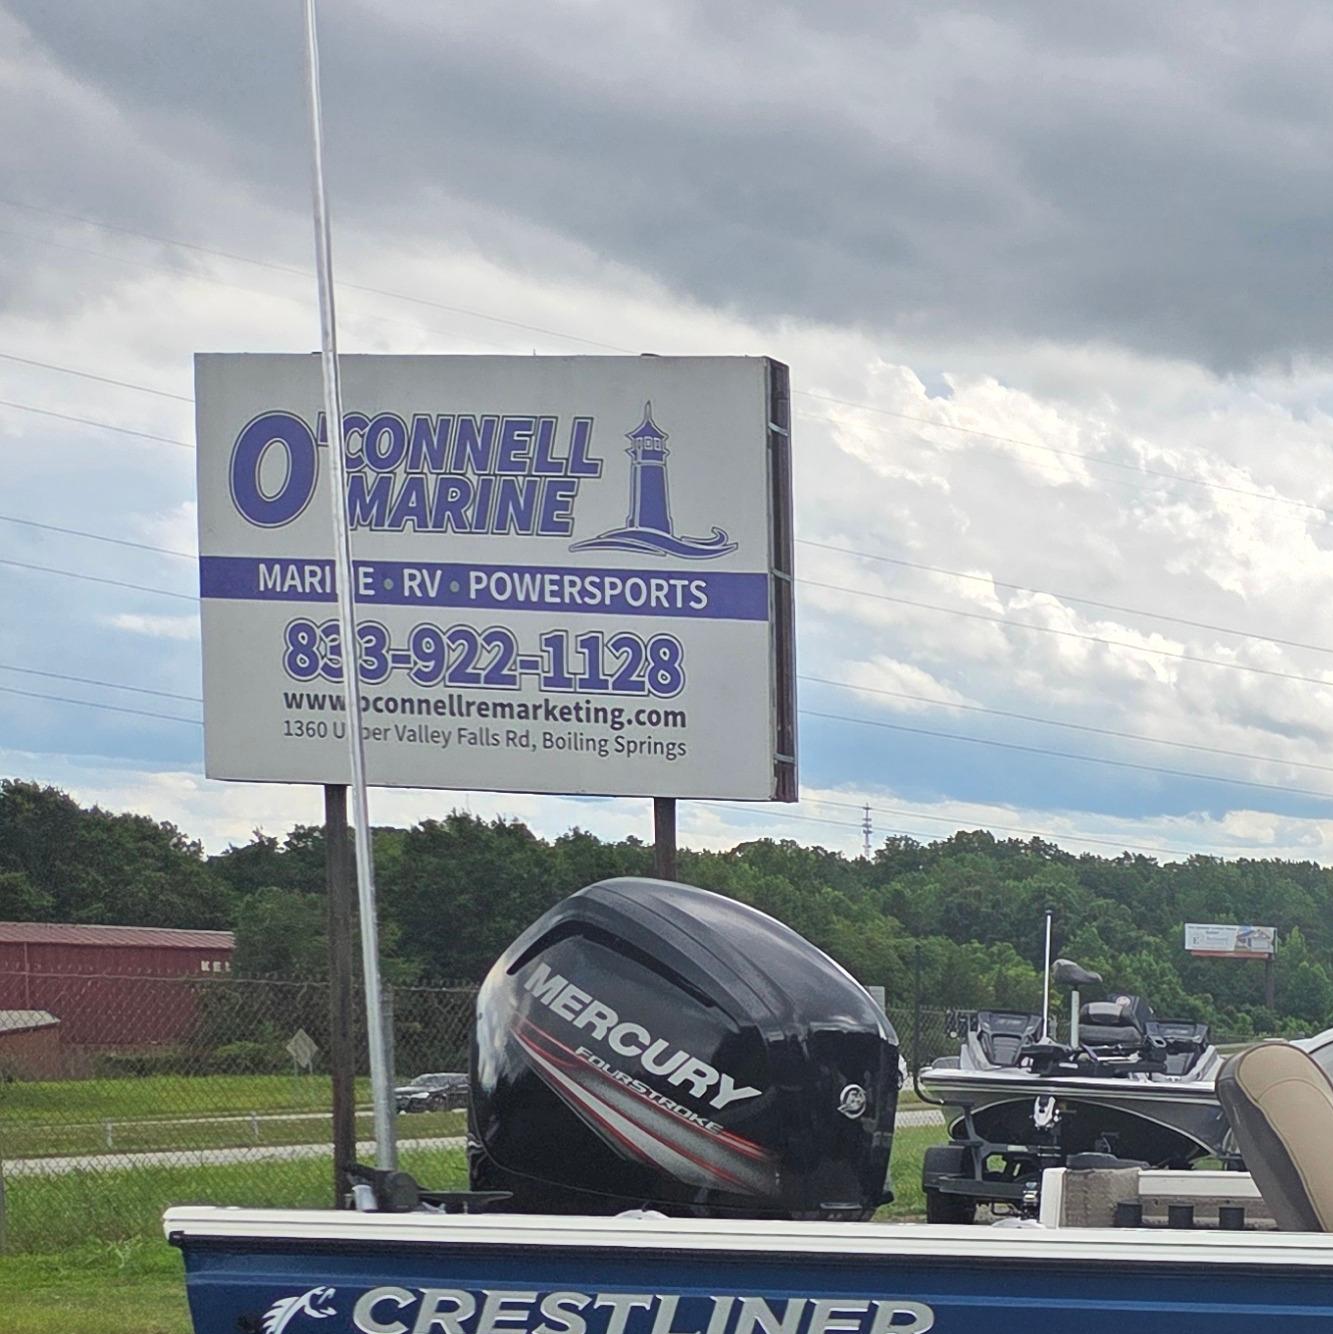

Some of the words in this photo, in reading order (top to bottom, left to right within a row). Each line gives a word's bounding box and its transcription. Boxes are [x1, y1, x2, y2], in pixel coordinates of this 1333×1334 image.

[229, 410, 603, 529] O'CONNELL
[348, 472, 580, 537] MARINE
[258, 563, 375, 595] MARIE
[403, 568, 442, 597] RV
[469, 570, 708, 609] POWERSPORTS
[283, 617, 685, 699] 833-922-1128
[283, 692, 686, 730] wwwoconnellremarketing.com
[283, 720, 328, 738] 1360
[333, 721, 391, 741] Uper
[395, 724, 452, 749] Valley
[458, 726, 500, 746] Falls
[506, 730, 537, 751] Rd,
[543, 731, 609, 758] Boiling
[614, 735, 687, 760] Springs
[524, 963, 762, 1109] MERCURY
[575, 1047, 724, 1135] FOURSTROKE
